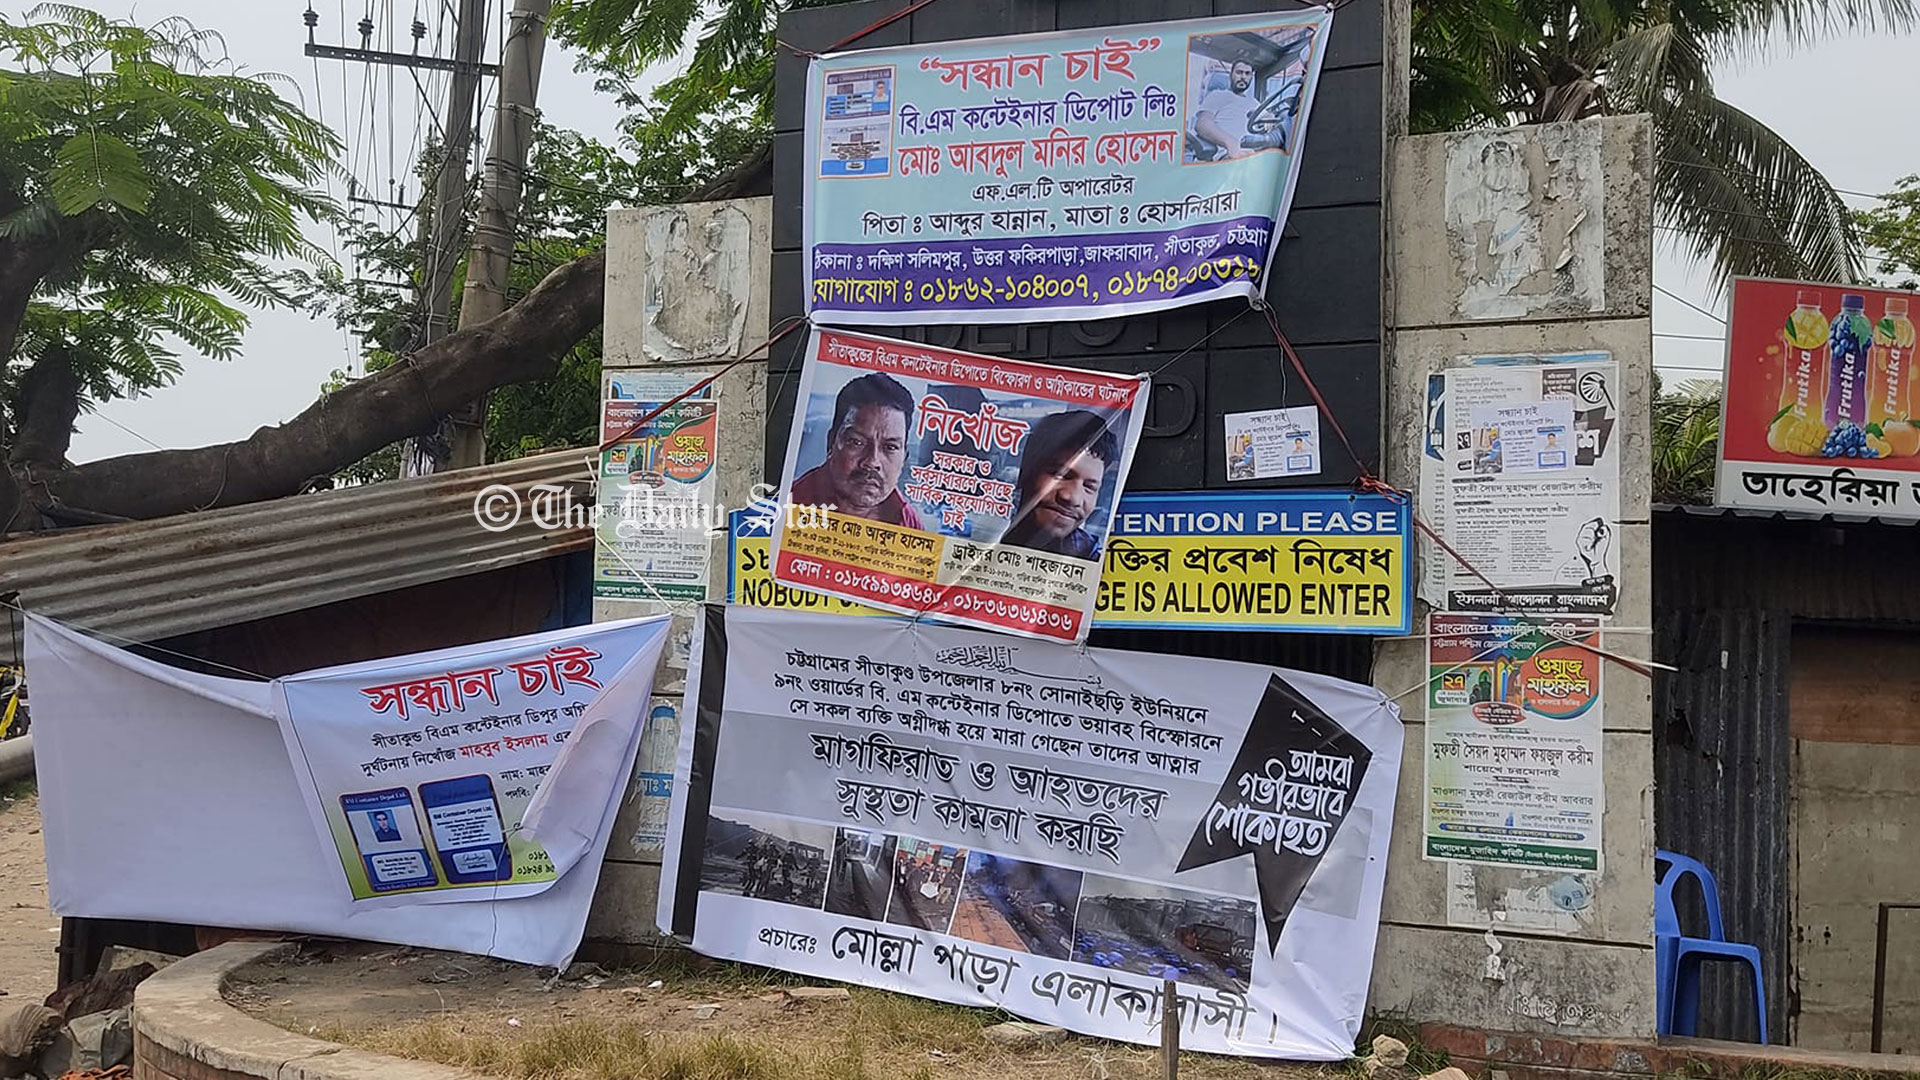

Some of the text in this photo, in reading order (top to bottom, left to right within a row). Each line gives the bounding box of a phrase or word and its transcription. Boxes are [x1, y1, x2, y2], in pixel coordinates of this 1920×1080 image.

[899, 104, 956, 136] বি.এম
[961, 97, 1058, 130] কন্টেইনার
[1063, 90, 1137, 124] ডিপোট
[1142, 85, 1176, 118] লিঃ
[897, 127, 1177, 177] মোঃ আবদুল মনির হোসেন
[972, 174, 1134, 203] এফ.এল.টি অপারেটর
[862, 211, 907, 236] পিতা
[929, 212, 985, 238] আব্দুর
[1063, 204, 1112, 227] মাতা
[1137, 188, 1242, 224] হোসনিয়ারা
[867, 249, 905, 271] দক্ষিণ
[971, 245, 1005, 267] উত্তর
[1793, 349, 1812, 419] Frutika
[1837, 352, 1856, 419] Frutika
[1883, 342, 1902, 416] Frutika
[915, 394, 1033, 456] নিখোঁজ
[932, 451, 991, 476] সরকার ও
[944, 490, 1014, 520] সহযোগিতা
[980, 479, 1015, 500] কাছে
[1741, 467, 1900, 506] তাহেরিয়া
[841, 520, 863, 538] মোঃ
[865, 526, 897, 547] আবুল
[900, 532, 935, 553] হাসেম
[943, 508, 966, 531] চাই
[1112, 510, 1398, 533] TENTION PLEASE
[789, 556, 823, 580] ফোন
[997, 550, 1022, 568] মোঃ
[1025, 554, 1087, 581] শাহজাহান
[1183, 543, 1281, 575] প্রবেশ
[1289, 538, 1395, 577] নিষেধ
[1134, 581, 1156, 612] IS
[1162, 581, 1292, 615] ALLOWED
[1301, 582, 1391, 617] ENTER
[358, 645, 605, 721] সন্ধান চাই
[785, 648, 850, 674] চট্টগ্রামের
[918, 664, 996, 694] উপজেলার
[1001, 677, 1034, 700] ৮নং
[1129, 694, 1209, 727] ইউনিয়নে
[1527, 674, 1590, 698] মাহফিল
[1534, 656, 1584, 680] ওয়াজ
[425, 724, 461, 742] বিএম
[464, 712, 524, 734] কন্টেইনার
[808, 676, 865, 699] ওয়ার্ডের
[897, 688, 923, 706] এম
[925, 691, 1001, 719] কন্টেইনার
[1006, 701, 1075, 728] ডিপোতে
[1079, 714, 1135, 742] ভয়াবহ
[412, 747, 457, 768] নিখোঁজ
[459, 742, 501, 760] মাহবুব
[503, 733, 550, 753] ইসলাম
[789, 698, 810, 716] সে
[814, 701, 852, 721] সকল
[856, 704, 894, 726] ব্যক্তি
[955, 721, 987, 742] হয়ে
[990, 726, 1026, 749] মারা
[1031, 733, 1084, 758] গেছেন
[1087, 742, 1142, 766] তাদের
[808, 730, 1169, 820] মাগফিরাত ও আহতদের
[1237, 757, 1348, 819] গভীরভাবে
[1287, 748, 1355, 790] আমরা
[933, 792, 1028, 843] কামনা
[1034, 810, 1125, 864] করছি
[1205, 800, 1333, 857] শোকাহত
[757, 926, 818, 955] প্রচারেঃ
[830, 925, 925, 976] মোল্লা
[933, 943, 1022, 995] পাড়া
